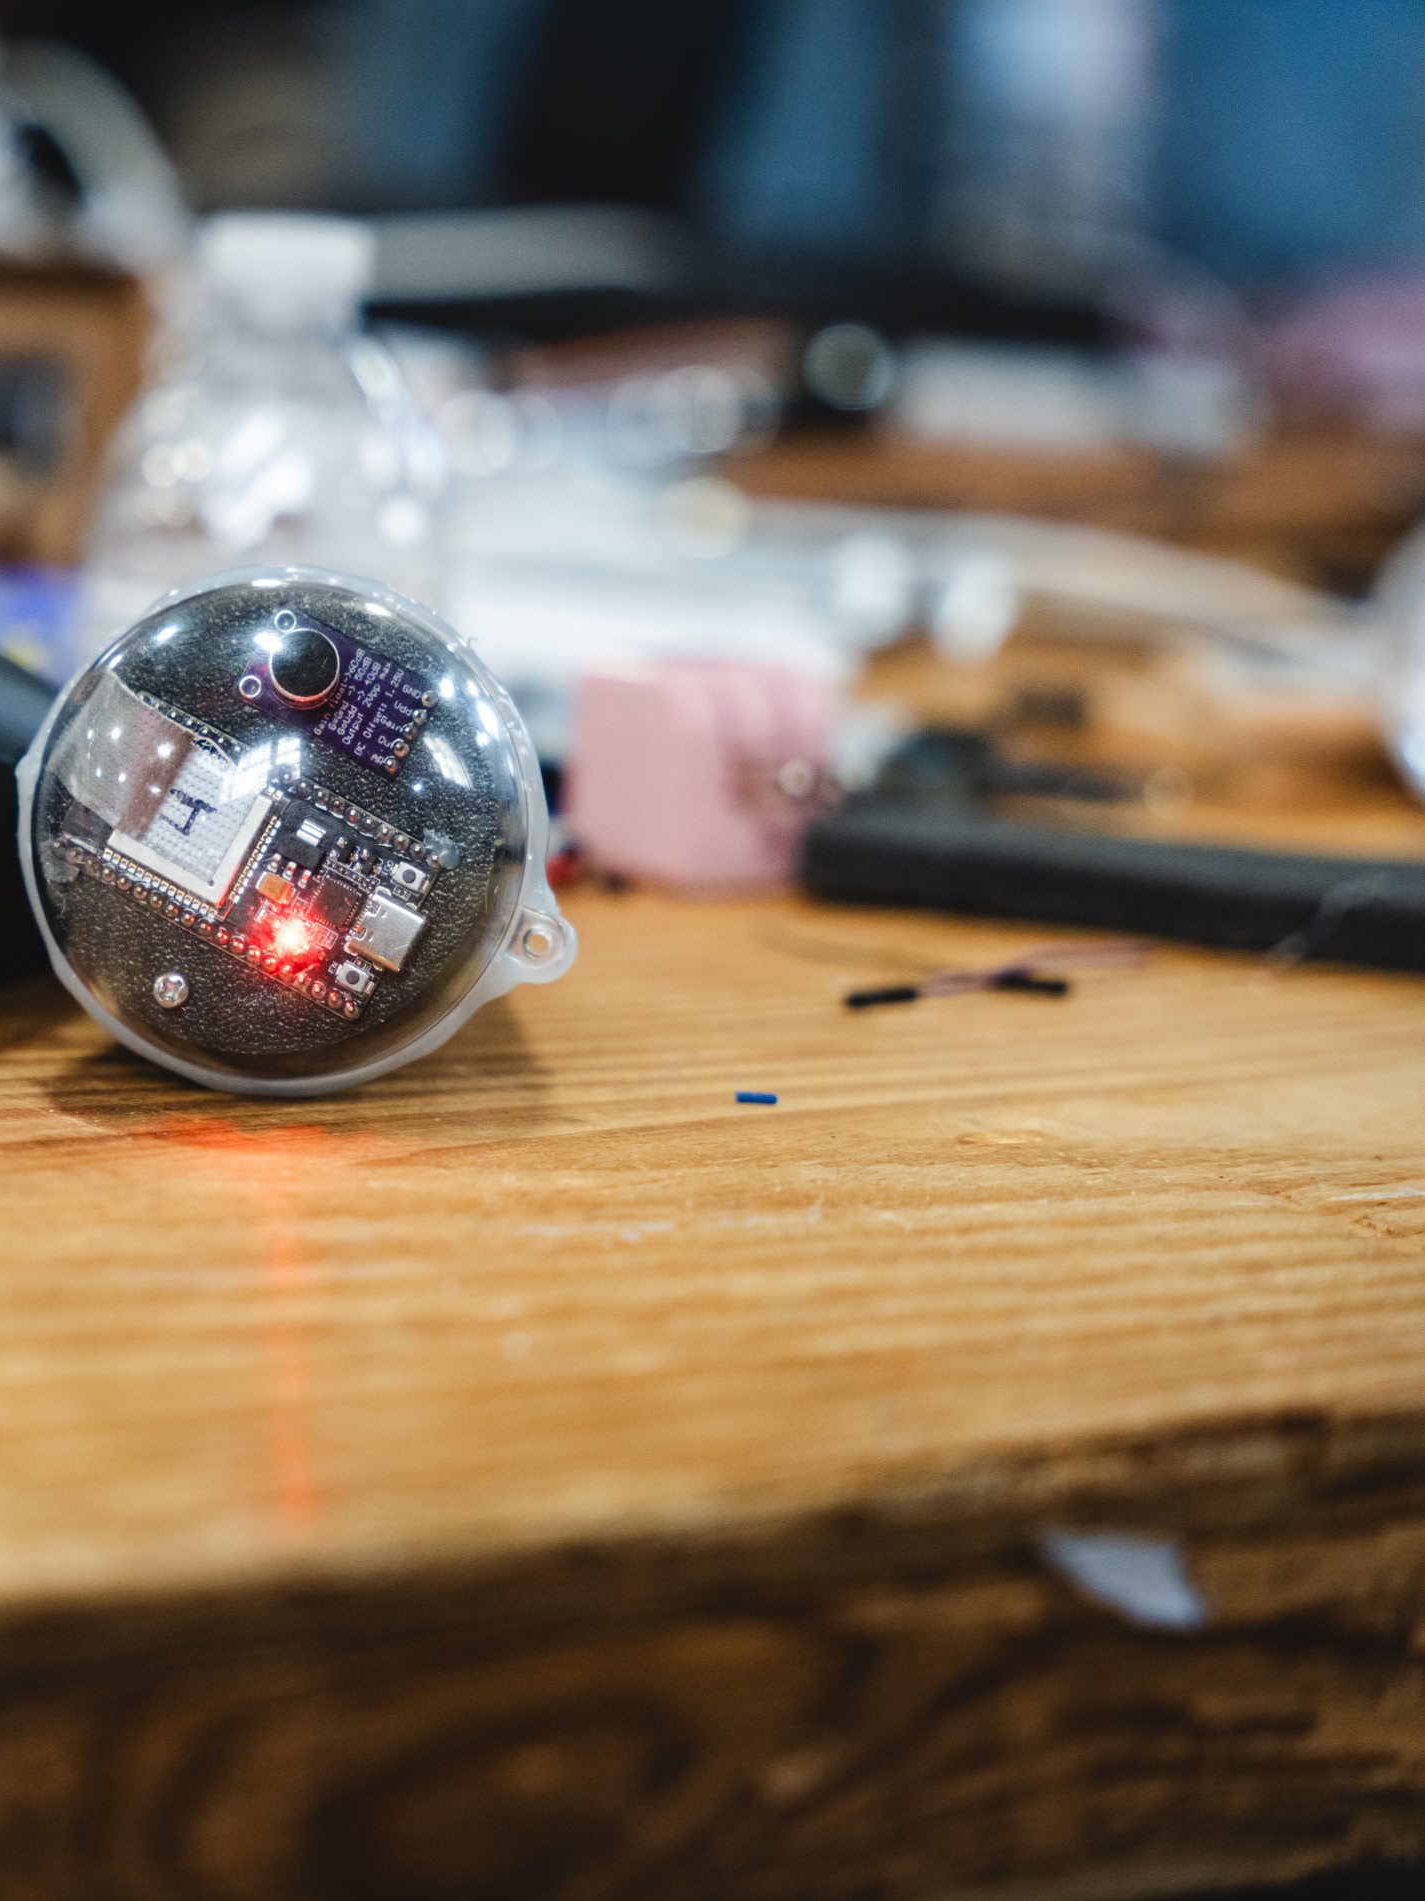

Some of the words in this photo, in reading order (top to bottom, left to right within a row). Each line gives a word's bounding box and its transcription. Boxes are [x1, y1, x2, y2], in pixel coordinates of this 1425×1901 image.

[326, 699, 350, 731] G=Gnd
[353, 655, 373, 682] 50dB
[335, 704, 358, 736] G=Vdd
[363, 661, 382, 687] 40dB
[401, 683, 422, 700] GND
[341, 711, 366, 746] Output
[361, 681, 382, 709] 2Vpp
[377, 661, 392, 681] max
[392, 700, 413, 716] Vdd
[312, 710, 331, 736] Gain
[353, 740, 366, 756] DC
[361, 700, 388, 739] Offset:
[378, 715, 404, 733] Gain
[376, 734, 395, 749] Ou
[327, 960, 339, 974] EN
